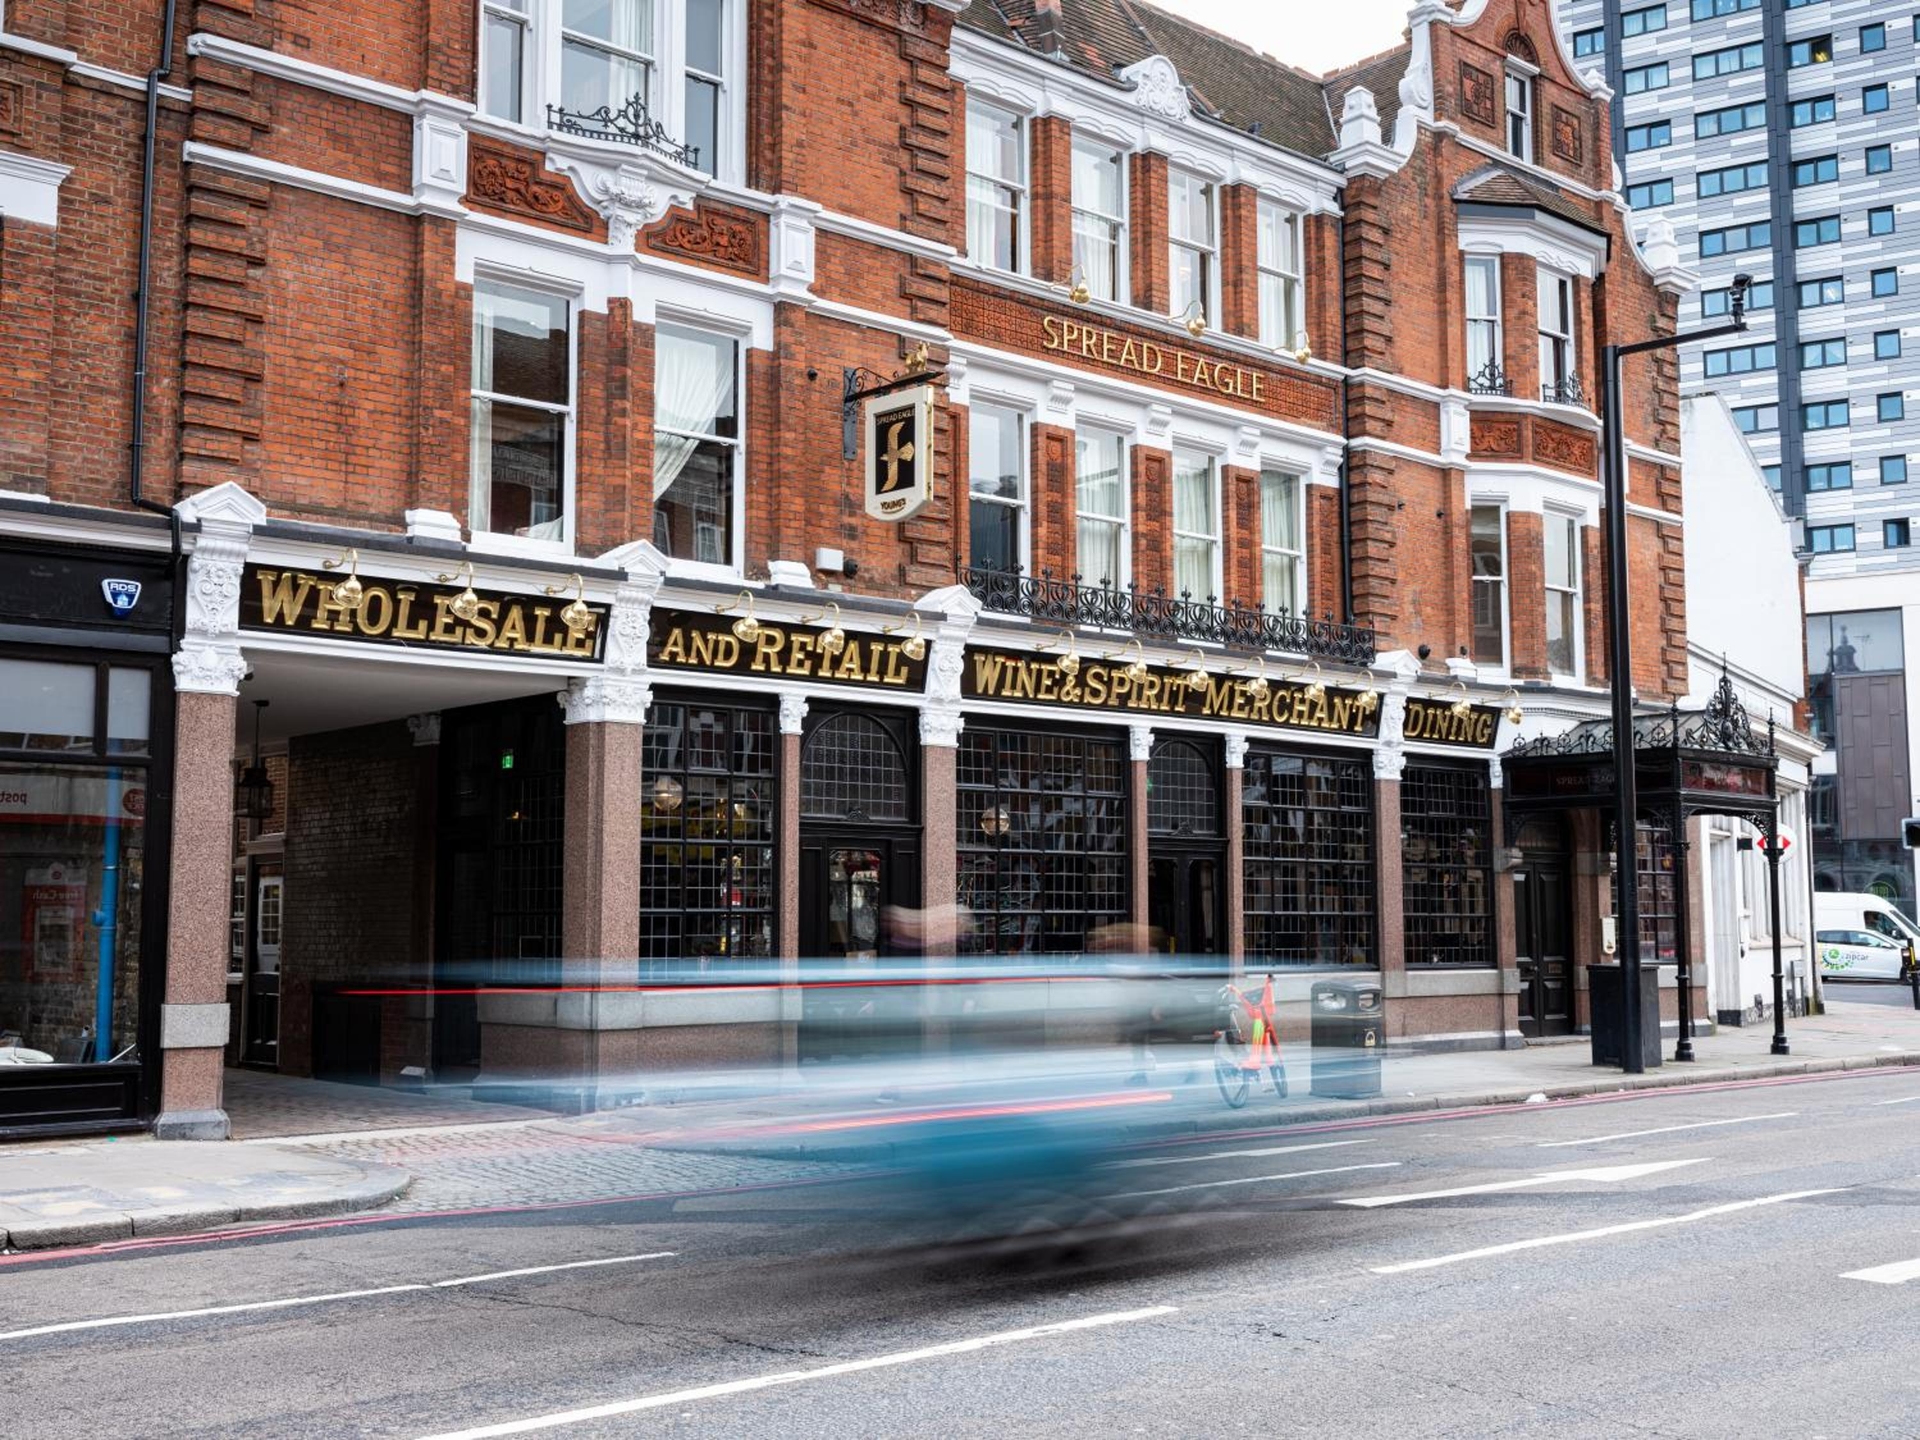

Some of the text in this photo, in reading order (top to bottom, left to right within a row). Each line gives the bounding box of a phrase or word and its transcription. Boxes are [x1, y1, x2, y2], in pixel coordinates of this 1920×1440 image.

[1043, 315, 1266, 402] SPREAD EAGLE
[256, 569, 597, 657] WHOLESALE
[659, 626, 910, 685] AND RETAIL
[1201, 675, 1374, 732] MERCHANT
[1404, 702, 1493, 743] DINING
